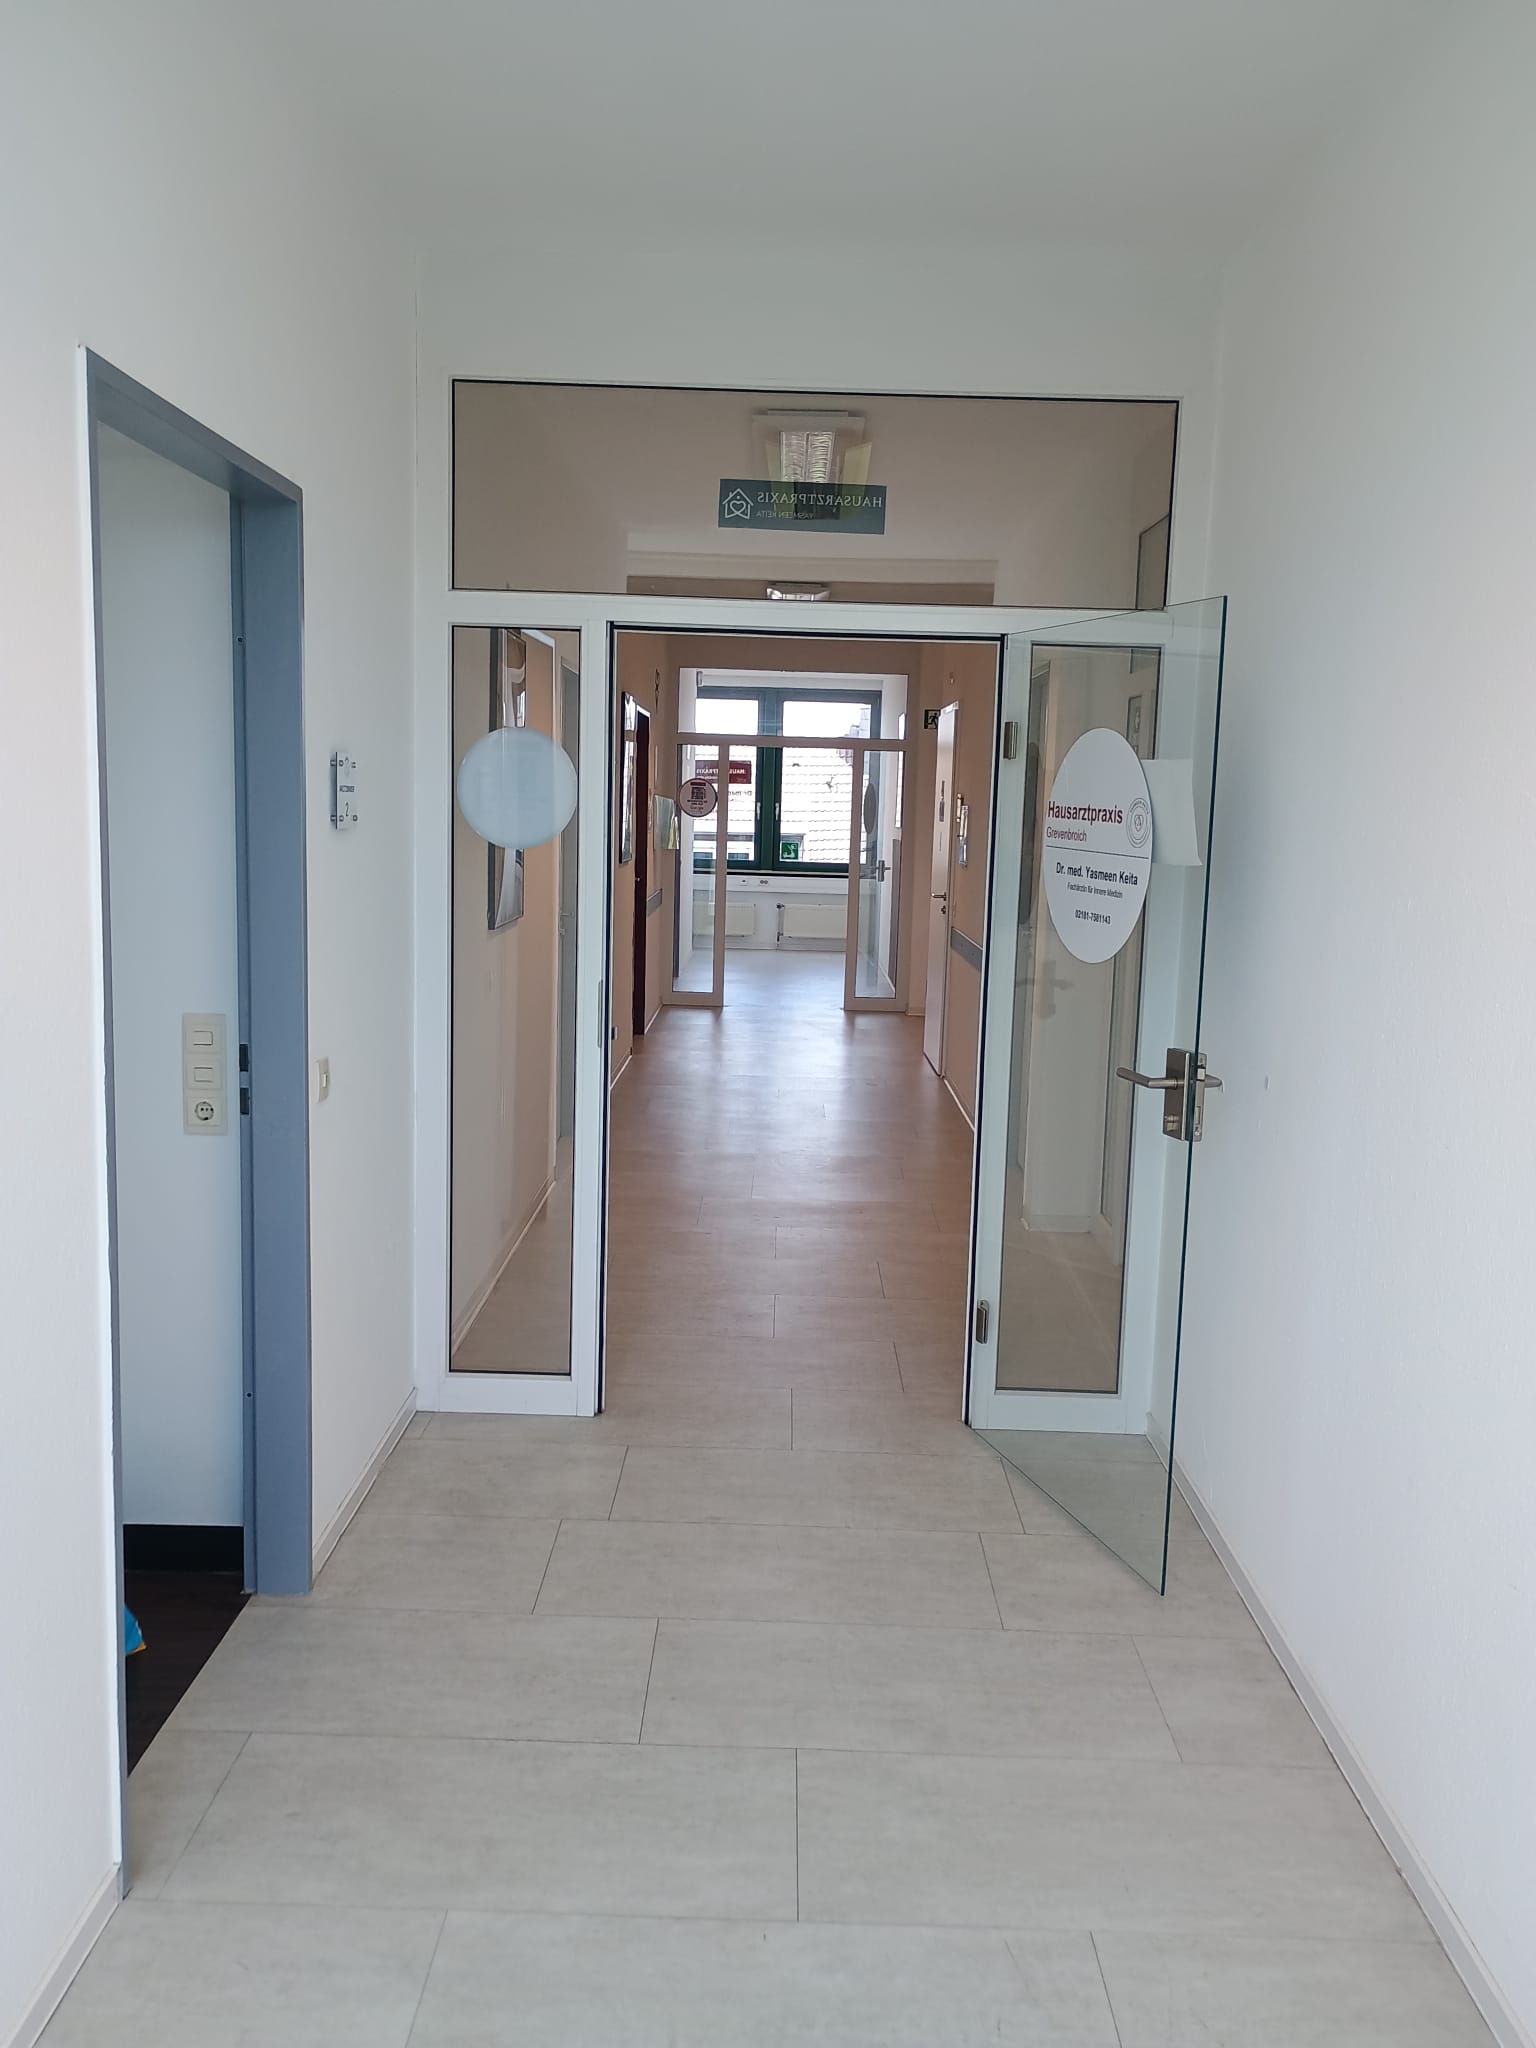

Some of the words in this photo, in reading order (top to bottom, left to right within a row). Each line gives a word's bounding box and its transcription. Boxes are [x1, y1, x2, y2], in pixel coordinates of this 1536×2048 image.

[1047, 801, 1123, 826] Hausarztpraxis
[1046, 826, 1087, 842] Grevenbroich
[1056, 862, 1066, 875] Dr.
[1067, 866, 1084, 878] med.
[1085, 866, 1117, 882] Yasmeen
[1119, 871, 1138, 886] Keita
